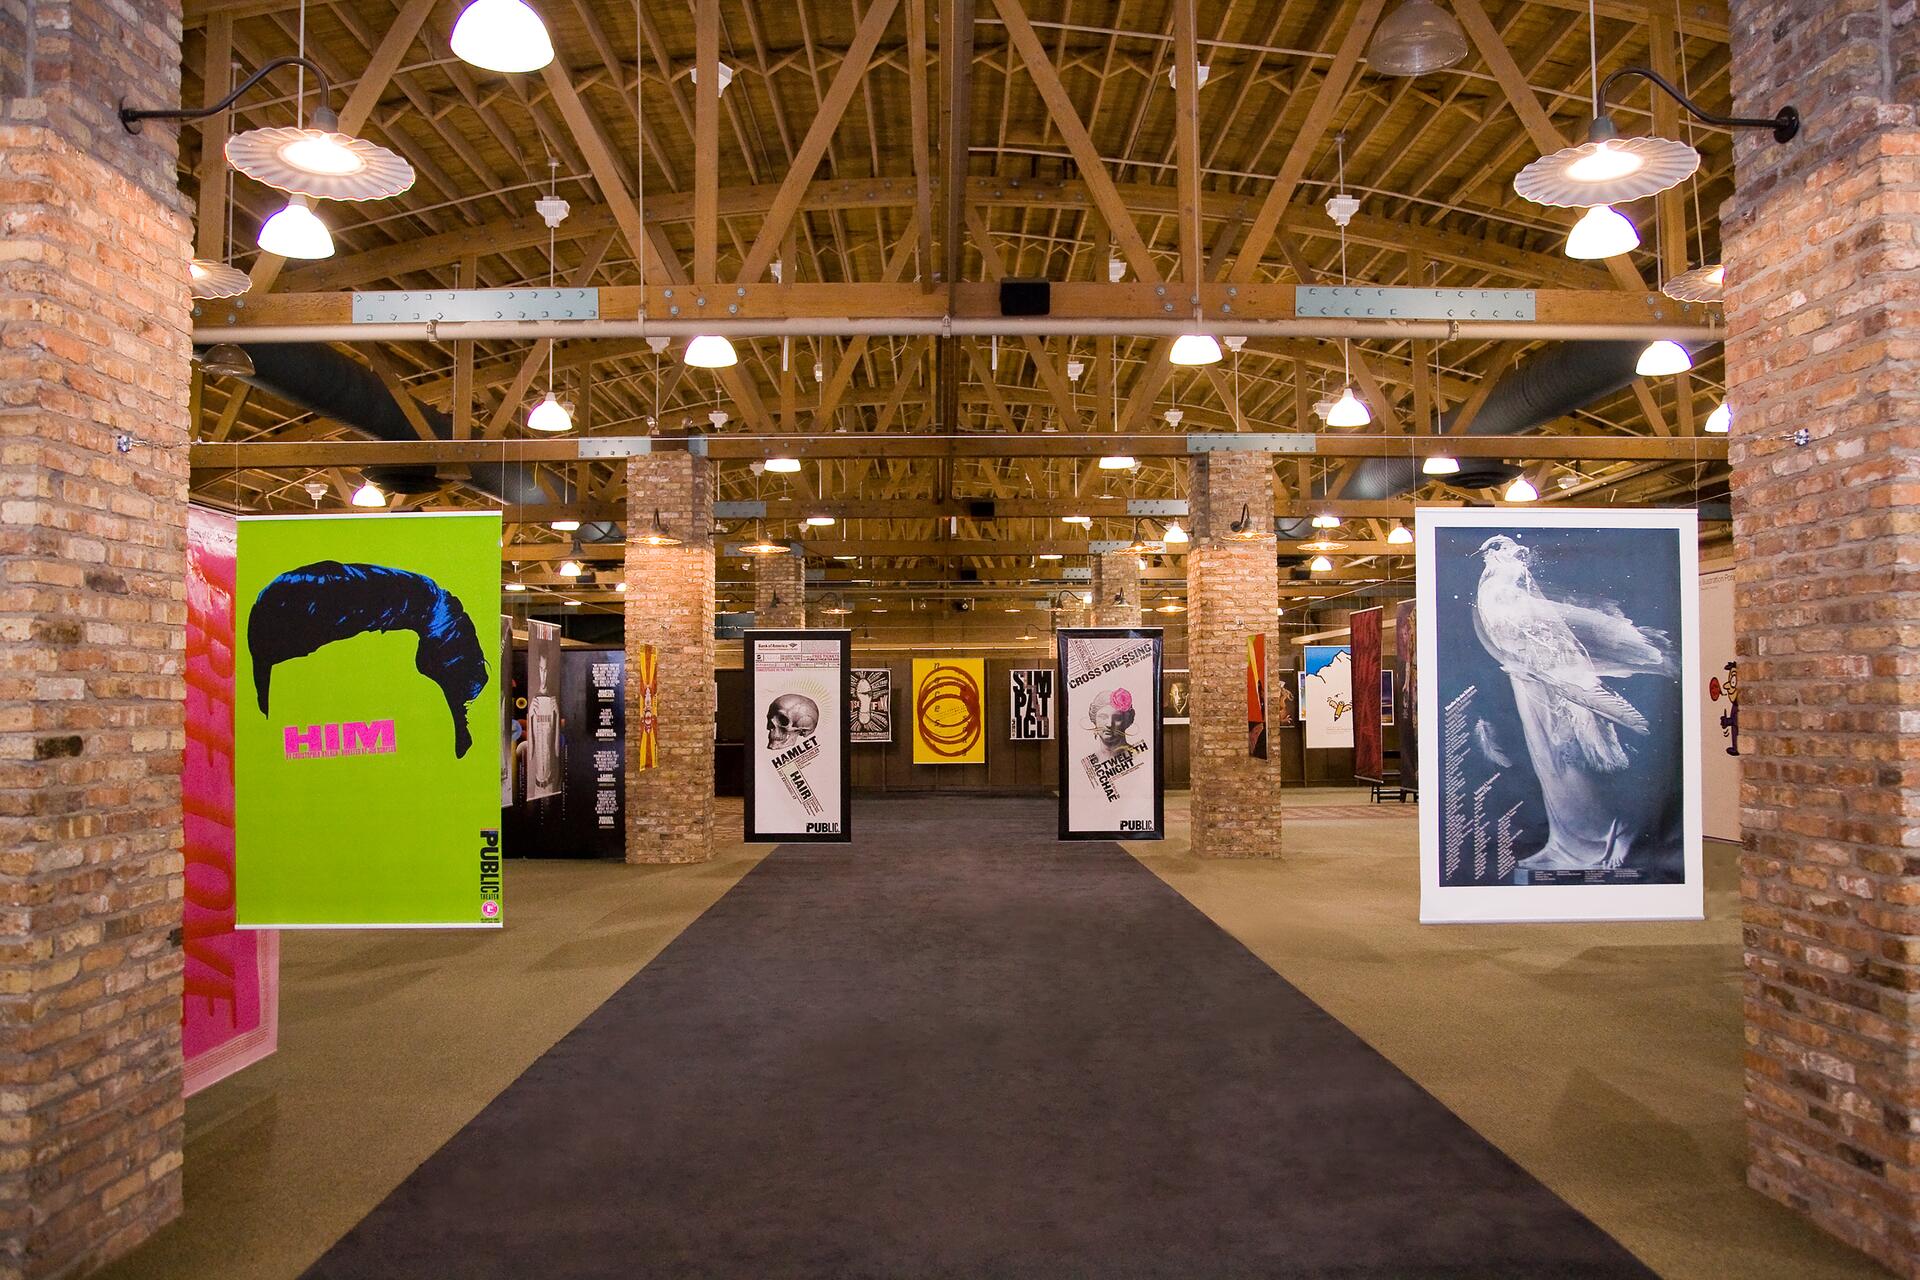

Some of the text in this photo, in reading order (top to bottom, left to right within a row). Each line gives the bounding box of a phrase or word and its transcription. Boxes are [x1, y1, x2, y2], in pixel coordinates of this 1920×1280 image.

[1069, 643, 1152, 689] CROSS-DRESSING
[284, 720, 396, 756] HIM
[771, 735, 818, 769] HAMLET
[1101, 742, 1148, 770] TWELFTH
[1105, 758, 1135, 778] NIGHT
[790, 770, 812, 800] HAIR
[1089, 757, 1118, 803] BACCHAE
[480, 831, 499, 893] PUBLIC
